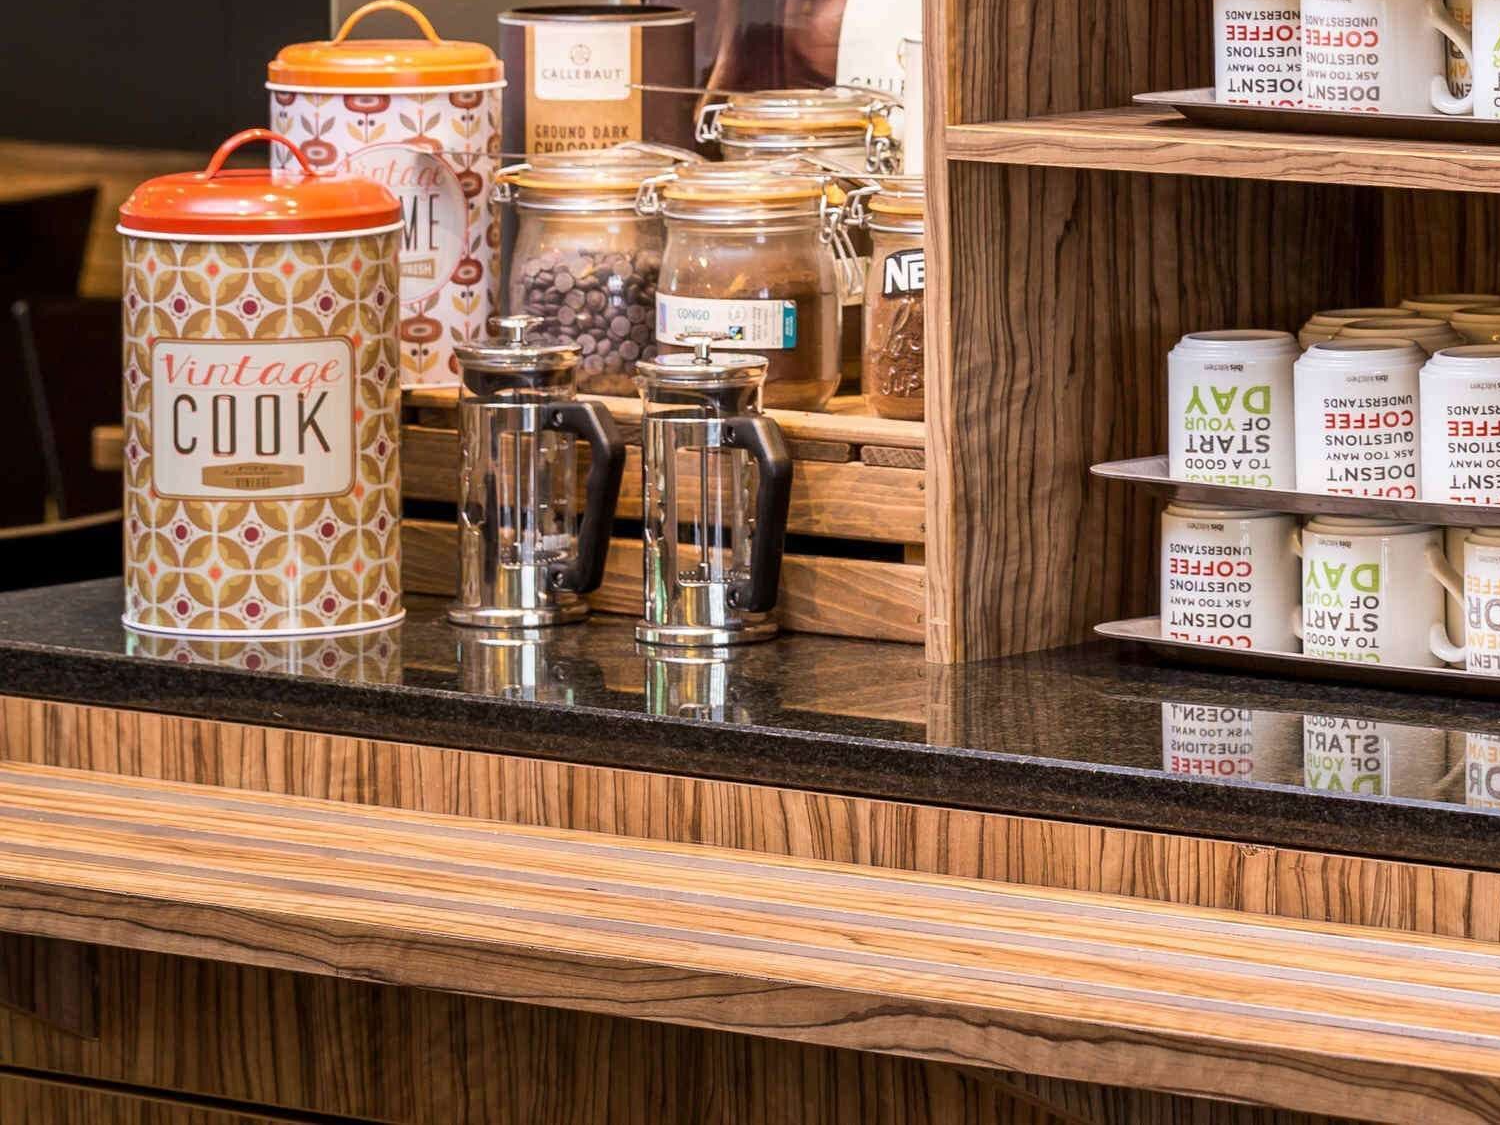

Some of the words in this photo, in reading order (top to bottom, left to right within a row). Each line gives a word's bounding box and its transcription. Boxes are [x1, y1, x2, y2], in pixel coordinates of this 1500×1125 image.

[1306, 29, 1379, 48] COFFEE
[1307, 86, 1380, 102] DOESN'T
[535, 125, 585, 139] GROUND
[593, 125, 629, 139] DARK
[160, 353, 342, 400] Vintage
[1185, 385, 1271, 415] DAY
[1323, 394, 1413, 408] UNDERSTANDS
[173, 390, 331, 456] COOK
[1185, 417, 1235, 431] YOUR
[1242, 417, 1271, 431] OF
[1325, 410, 1414, 429] COFFEE
[1185, 434, 1271, 453] START
[1325, 431, 1414, 446] QUESTIONS
[1326, 452, 1360, 460] MANY
[1364, 451, 1389, 460] TOO
[1394, 449, 1414, 459] ASK
[1185, 458, 1227, 470] GOOD
[1232, 458, 1243, 469] A
[1249, 458, 1271, 469] TO
[1449, 459, 1482, 468] MANY
[1327, 463, 1415, 481] DOESN'T
[1170, 543, 1252, 556] UNDERSTANDS
[1170, 558, 1252, 577] COFFEE
[1306, 559, 1379, 593] DAY
[1170, 579, 1252, 593] QUESTIONS
[1170, 596, 1195, 606] MANY
[1198, 598, 1221, 607] TOO
[1227, 598, 1252, 608] ASK
[1350, 596, 1379, 610] OF
[1170, 612, 1252, 629] DOESN'T
[1306, 609, 1379, 633] START
